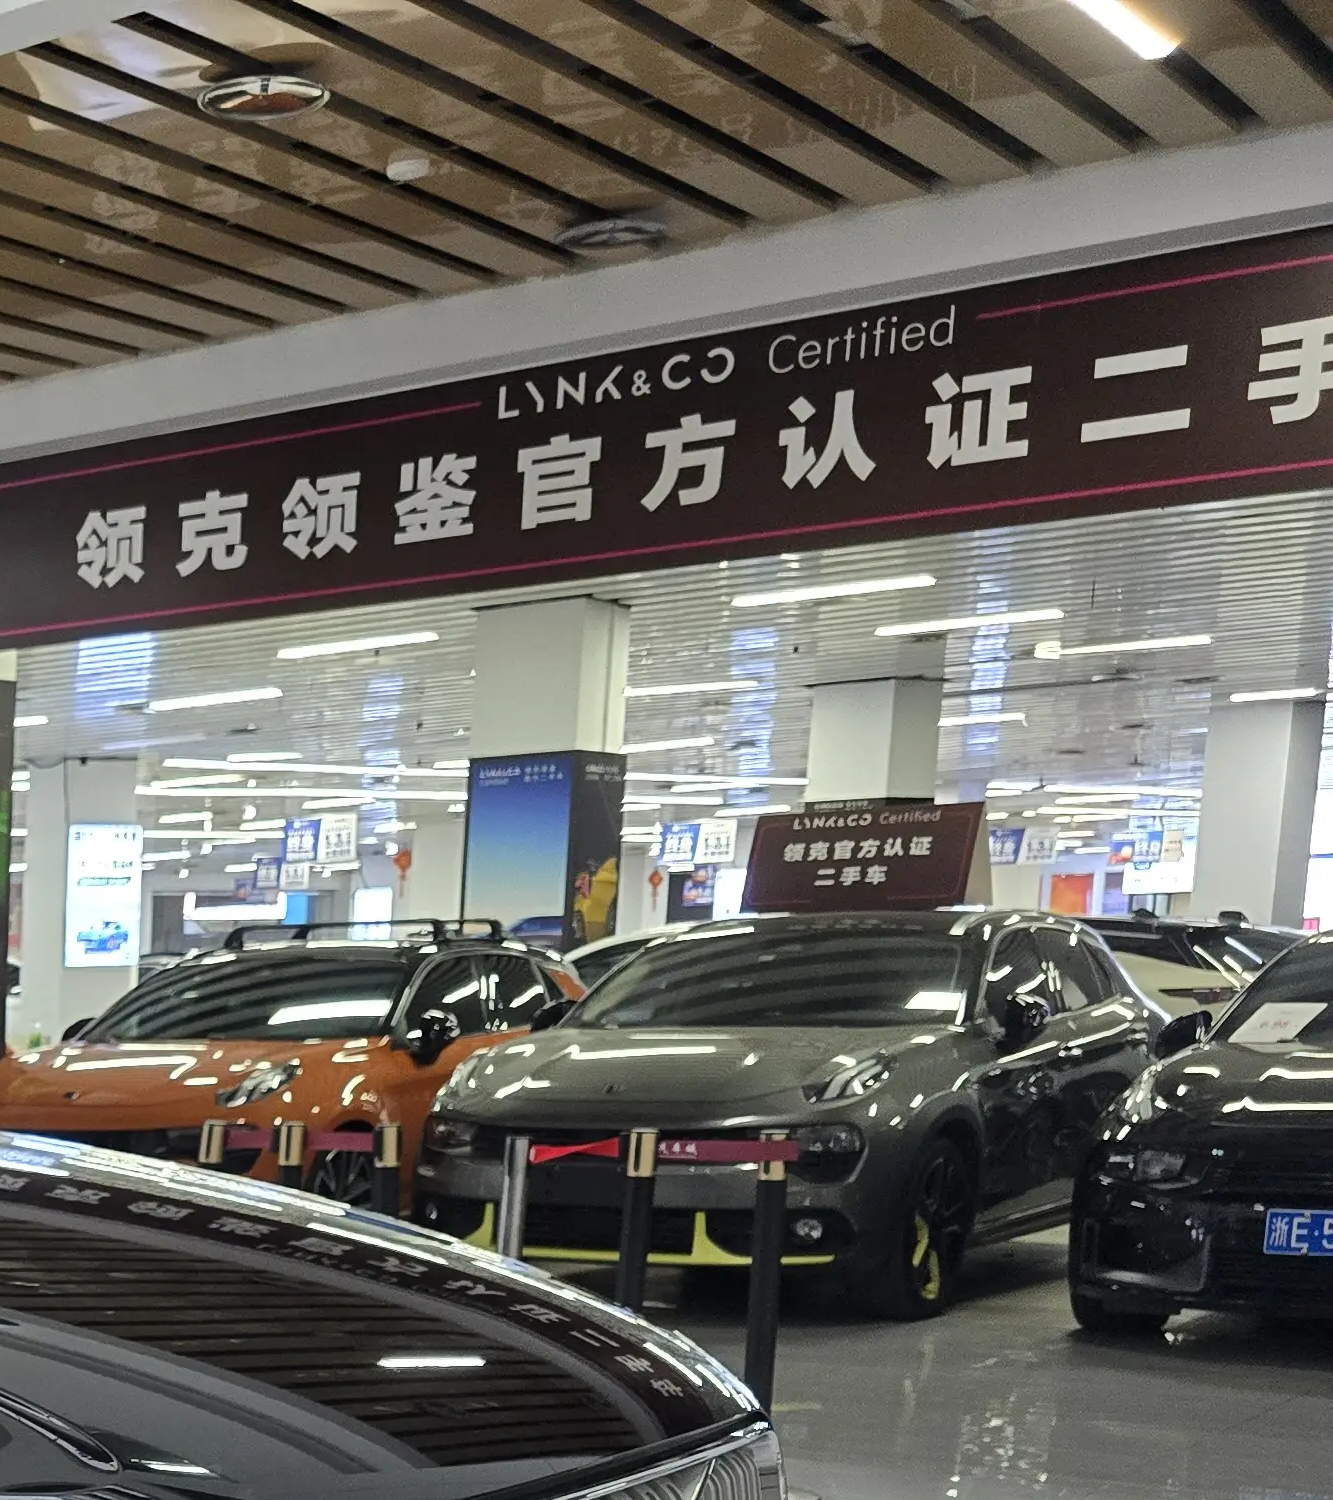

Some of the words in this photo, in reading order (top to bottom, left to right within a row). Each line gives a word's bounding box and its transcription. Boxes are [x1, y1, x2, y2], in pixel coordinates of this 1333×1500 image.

[496, 346, 735, 420] LYNK&CO
[768, 304, 957, 375] Certified
[75, 315, 1333, 590] 领克领鉴官方认证二手
[879, 809, 942, 825] Certified
[783, 836, 933, 863] 领克官方认证
[813, 864, 889, 886] 二手车
